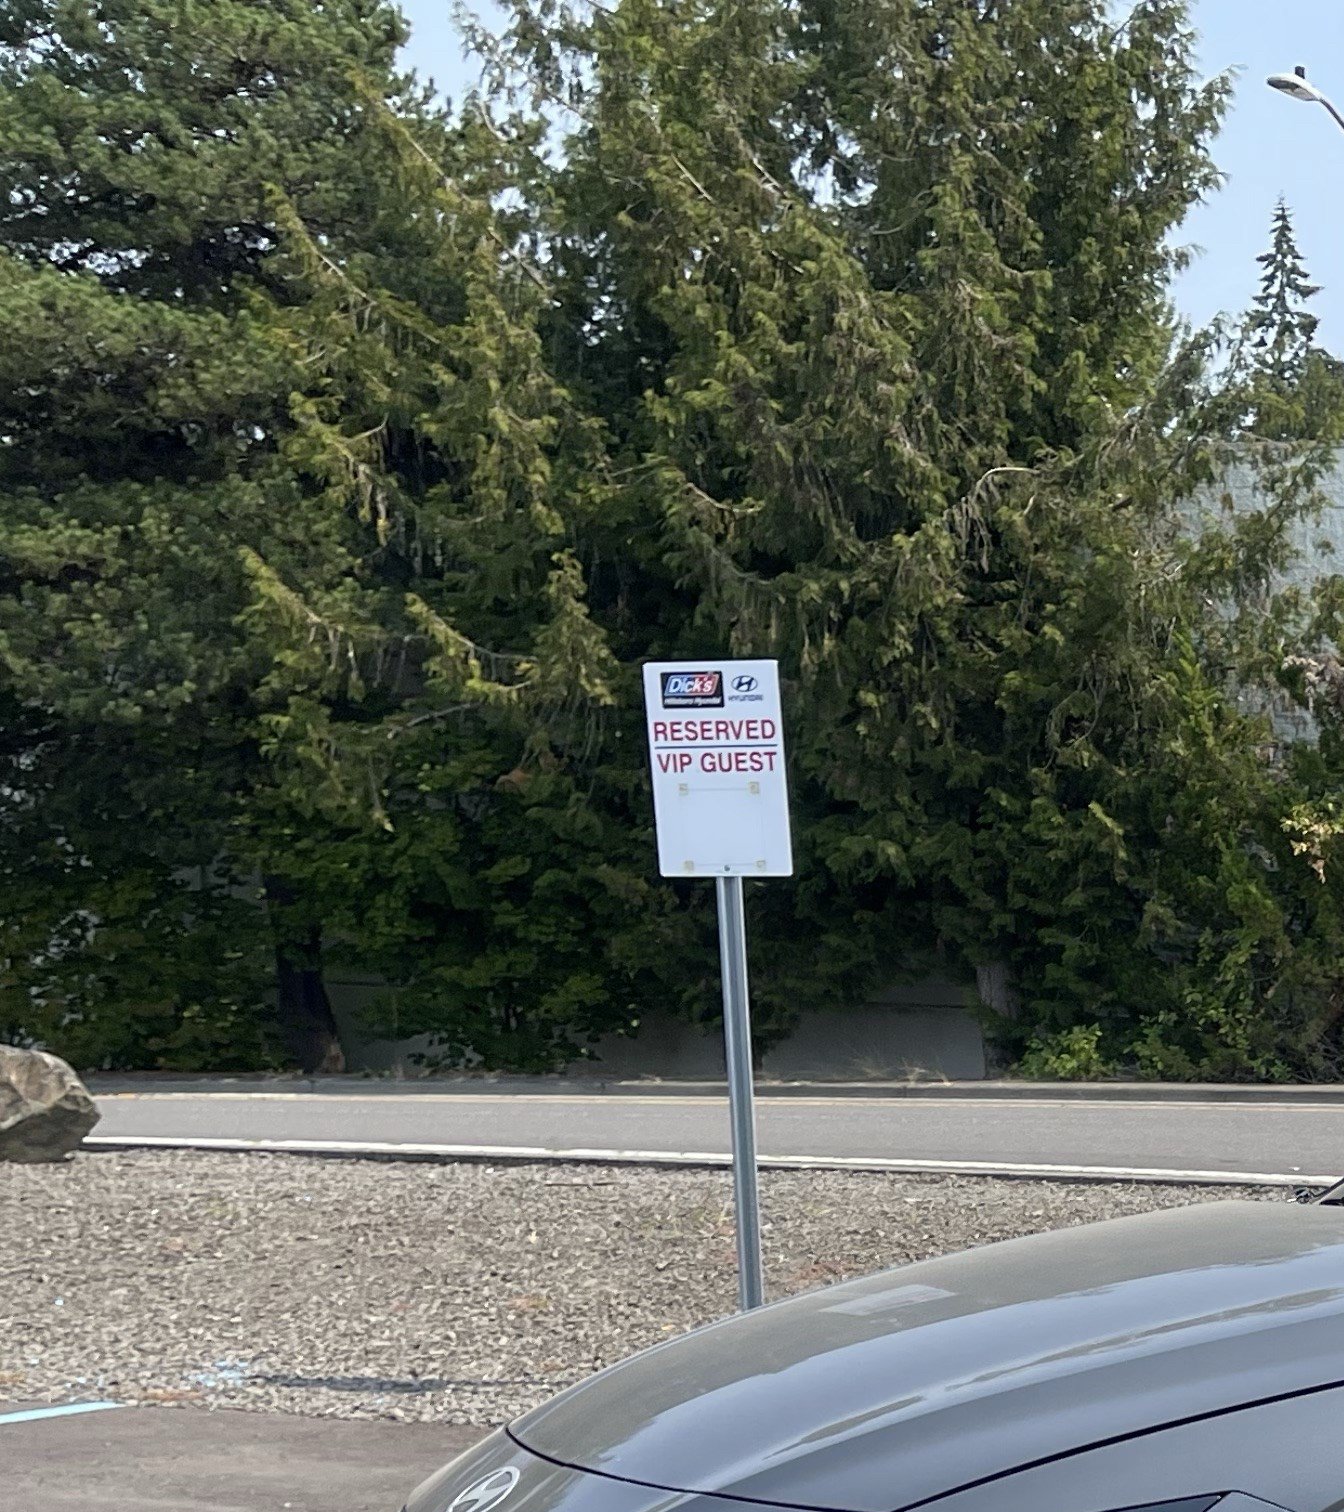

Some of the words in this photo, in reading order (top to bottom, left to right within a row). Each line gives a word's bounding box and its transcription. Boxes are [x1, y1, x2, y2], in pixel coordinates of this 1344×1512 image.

[653, 719, 776, 742] RESERVED
[657, 753, 693, 773] VIP
[700, 752, 778, 773] GUEST
